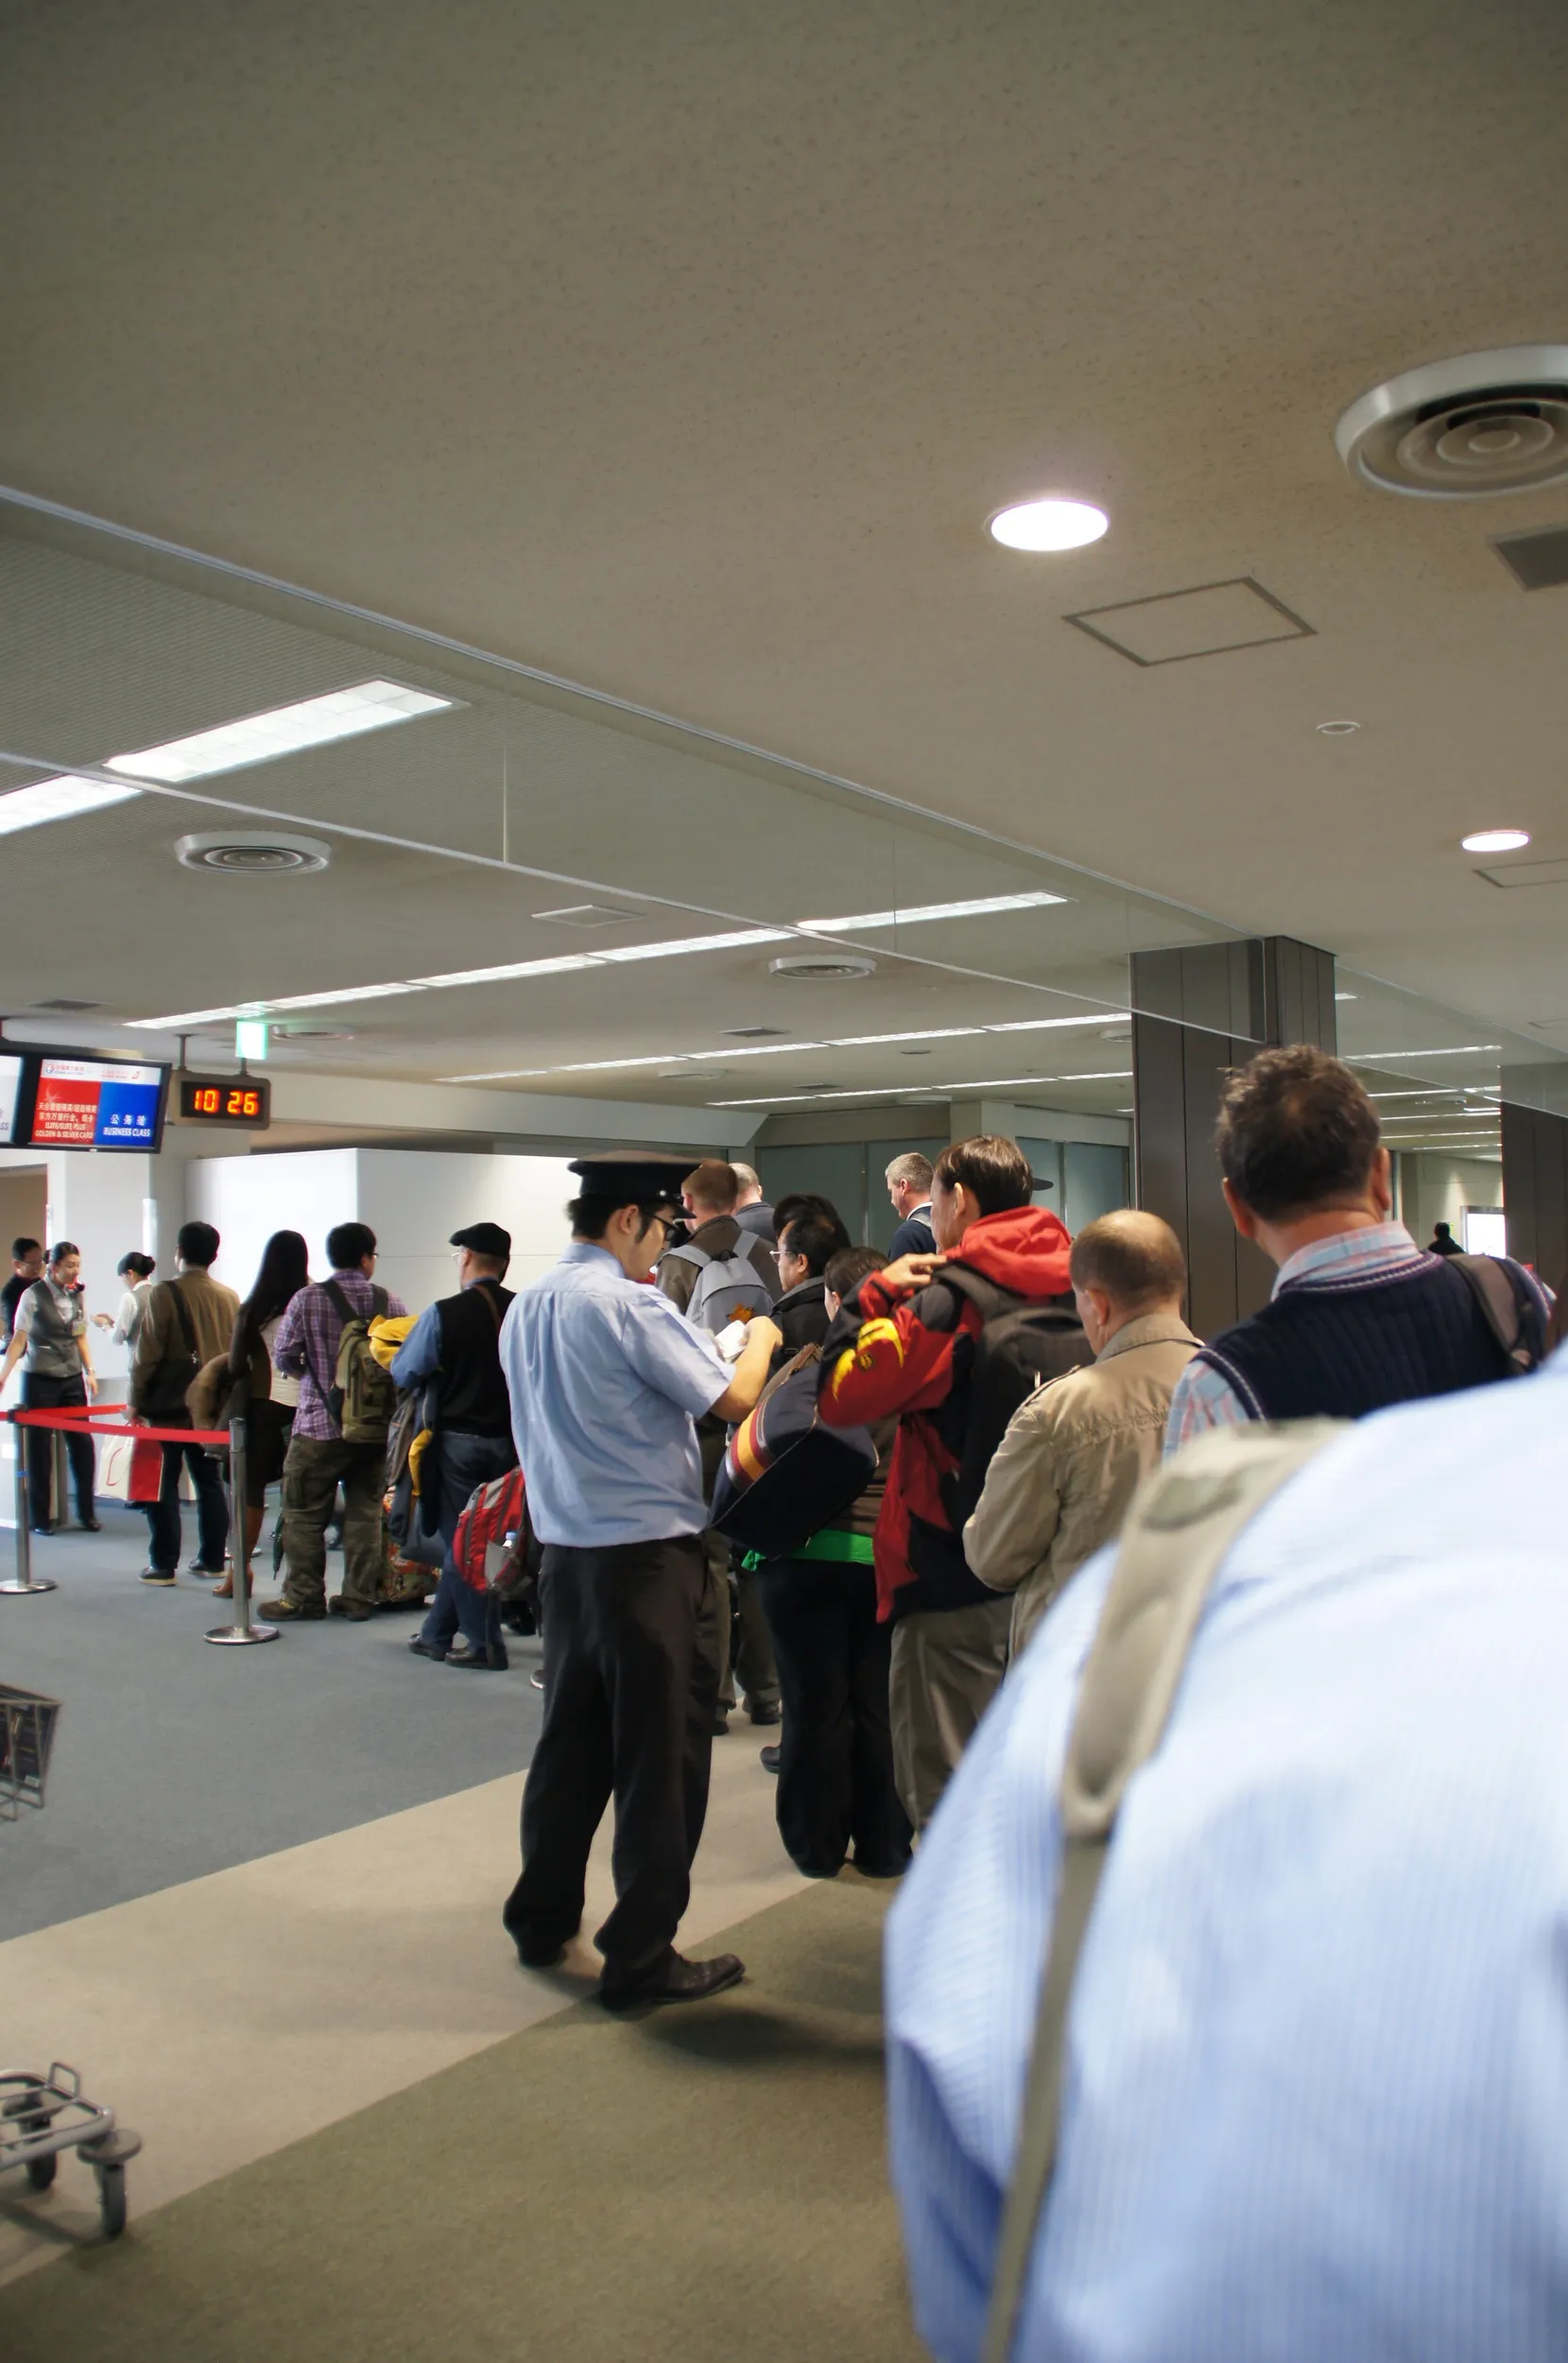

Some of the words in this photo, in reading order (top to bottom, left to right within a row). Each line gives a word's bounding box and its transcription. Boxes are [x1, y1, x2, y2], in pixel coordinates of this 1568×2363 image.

[194, 1089, 219, 1113] 10
[227, 1091, 259, 1115] 26
[103, 1127, 131, 1136] BUSINESS
[132, 1128, 151, 1137] CLASS
